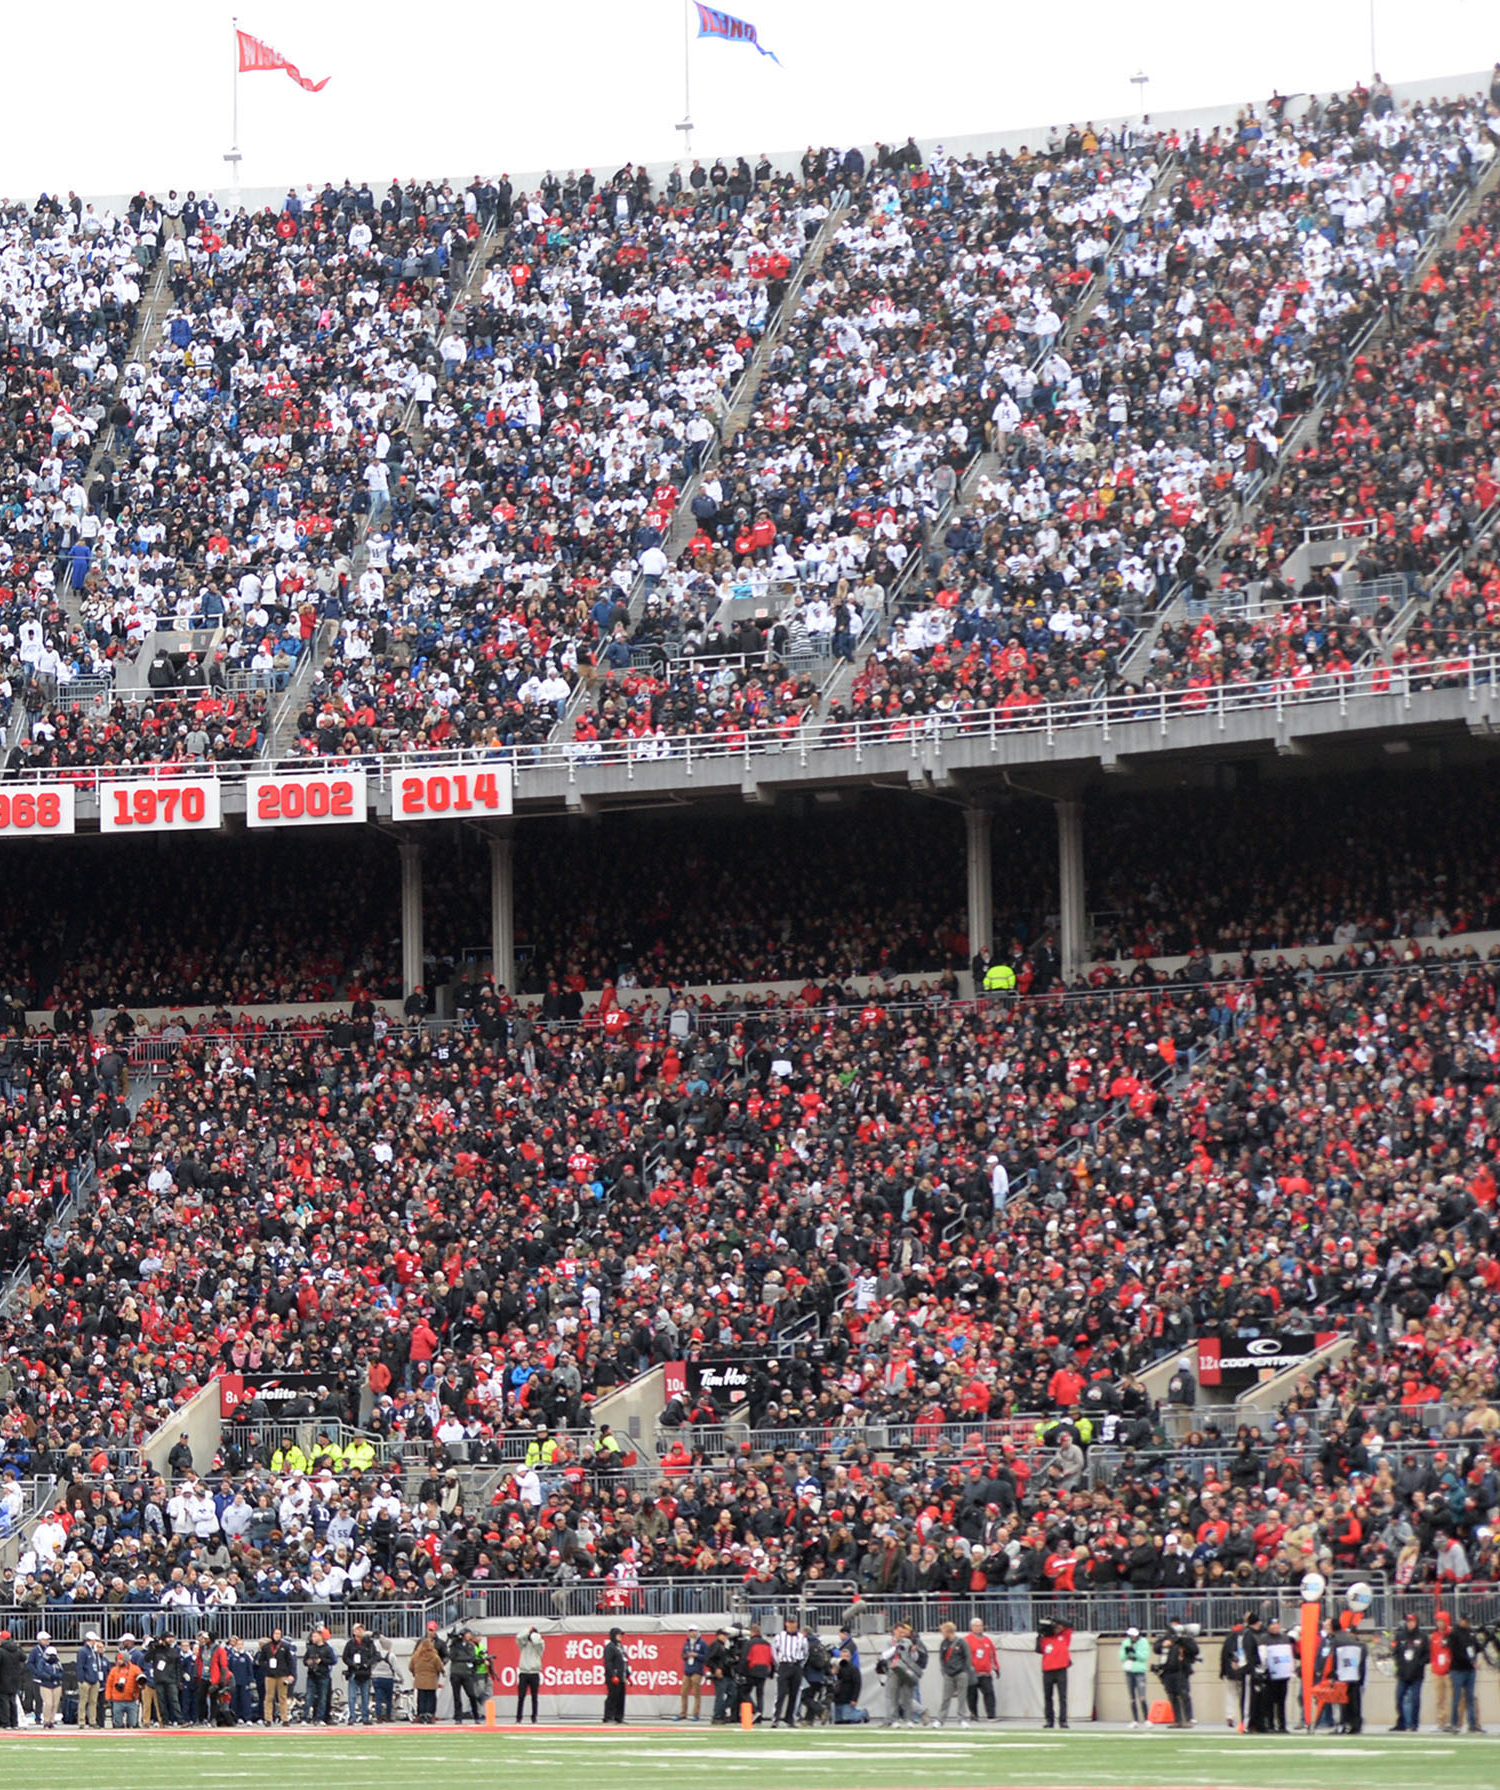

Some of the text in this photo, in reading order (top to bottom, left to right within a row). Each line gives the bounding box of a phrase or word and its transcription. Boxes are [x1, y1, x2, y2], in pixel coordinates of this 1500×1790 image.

[257, 780, 354, 819] 2002
[401, 773, 500, 813] 2014
[113, 786, 206, 825] 1970
[438, 1048, 449, 1060] 15
[406, 1261, 413, 1272] 2
[565, 1263, 576, 1275] 15
[699, 1368, 723, 1386] Tim
[225, 1390, 239, 1404] 8A
[255, 1387, 297, 1400] afelite
[319, 1510, 330, 1522] 11
[338, 1530, 347, 1538] 55
[565, 1638, 658, 1660] #Gocks
